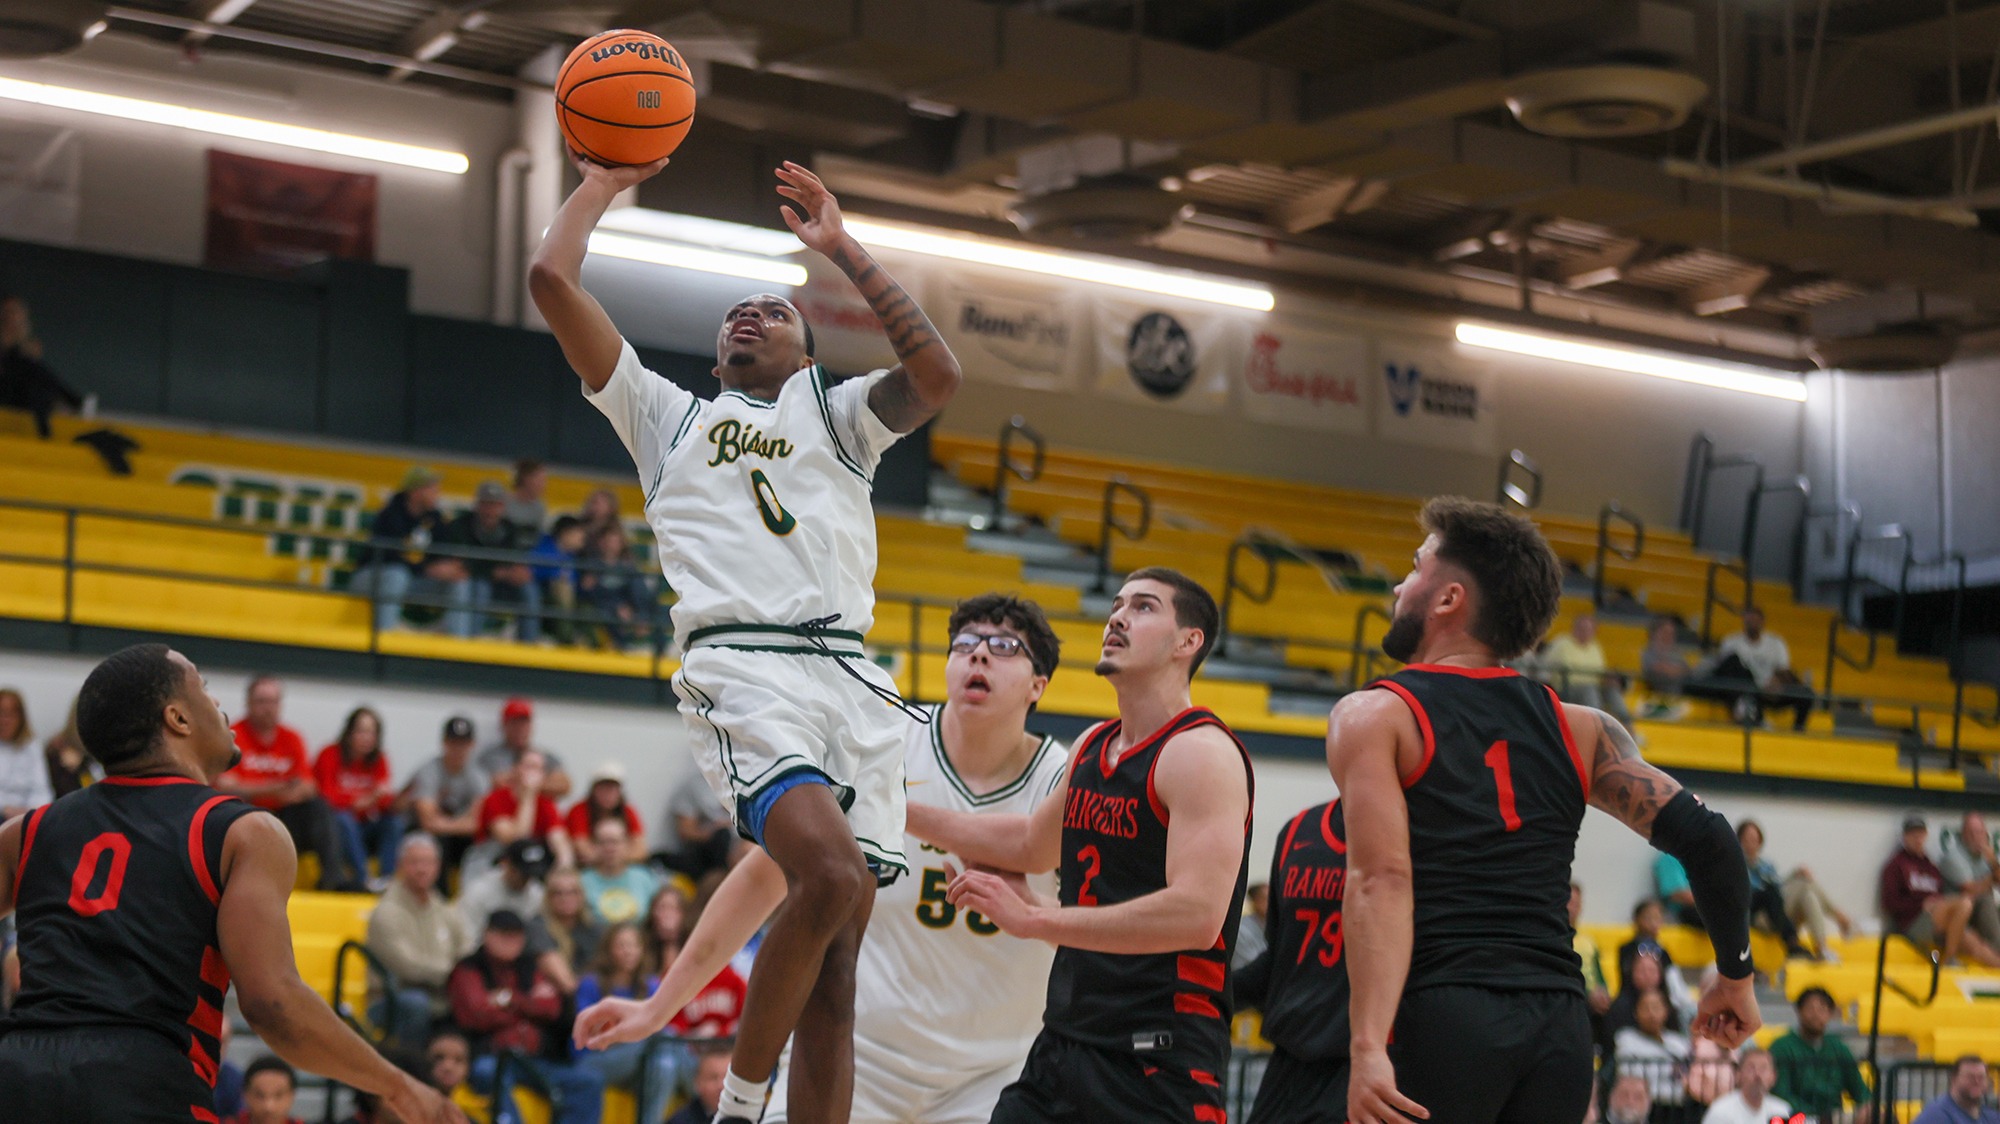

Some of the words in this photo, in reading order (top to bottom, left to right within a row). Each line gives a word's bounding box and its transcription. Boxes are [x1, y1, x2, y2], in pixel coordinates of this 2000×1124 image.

[591, 41, 683, 72] Wilson
[637, 90, 661, 109] OBU
[749, 467, 798, 537] 0
[1484, 739, 1523, 832] 1
[67, 832, 132, 917] 0
[1077, 844, 1101, 907] 2
[1295, 908, 1345, 969] 79
